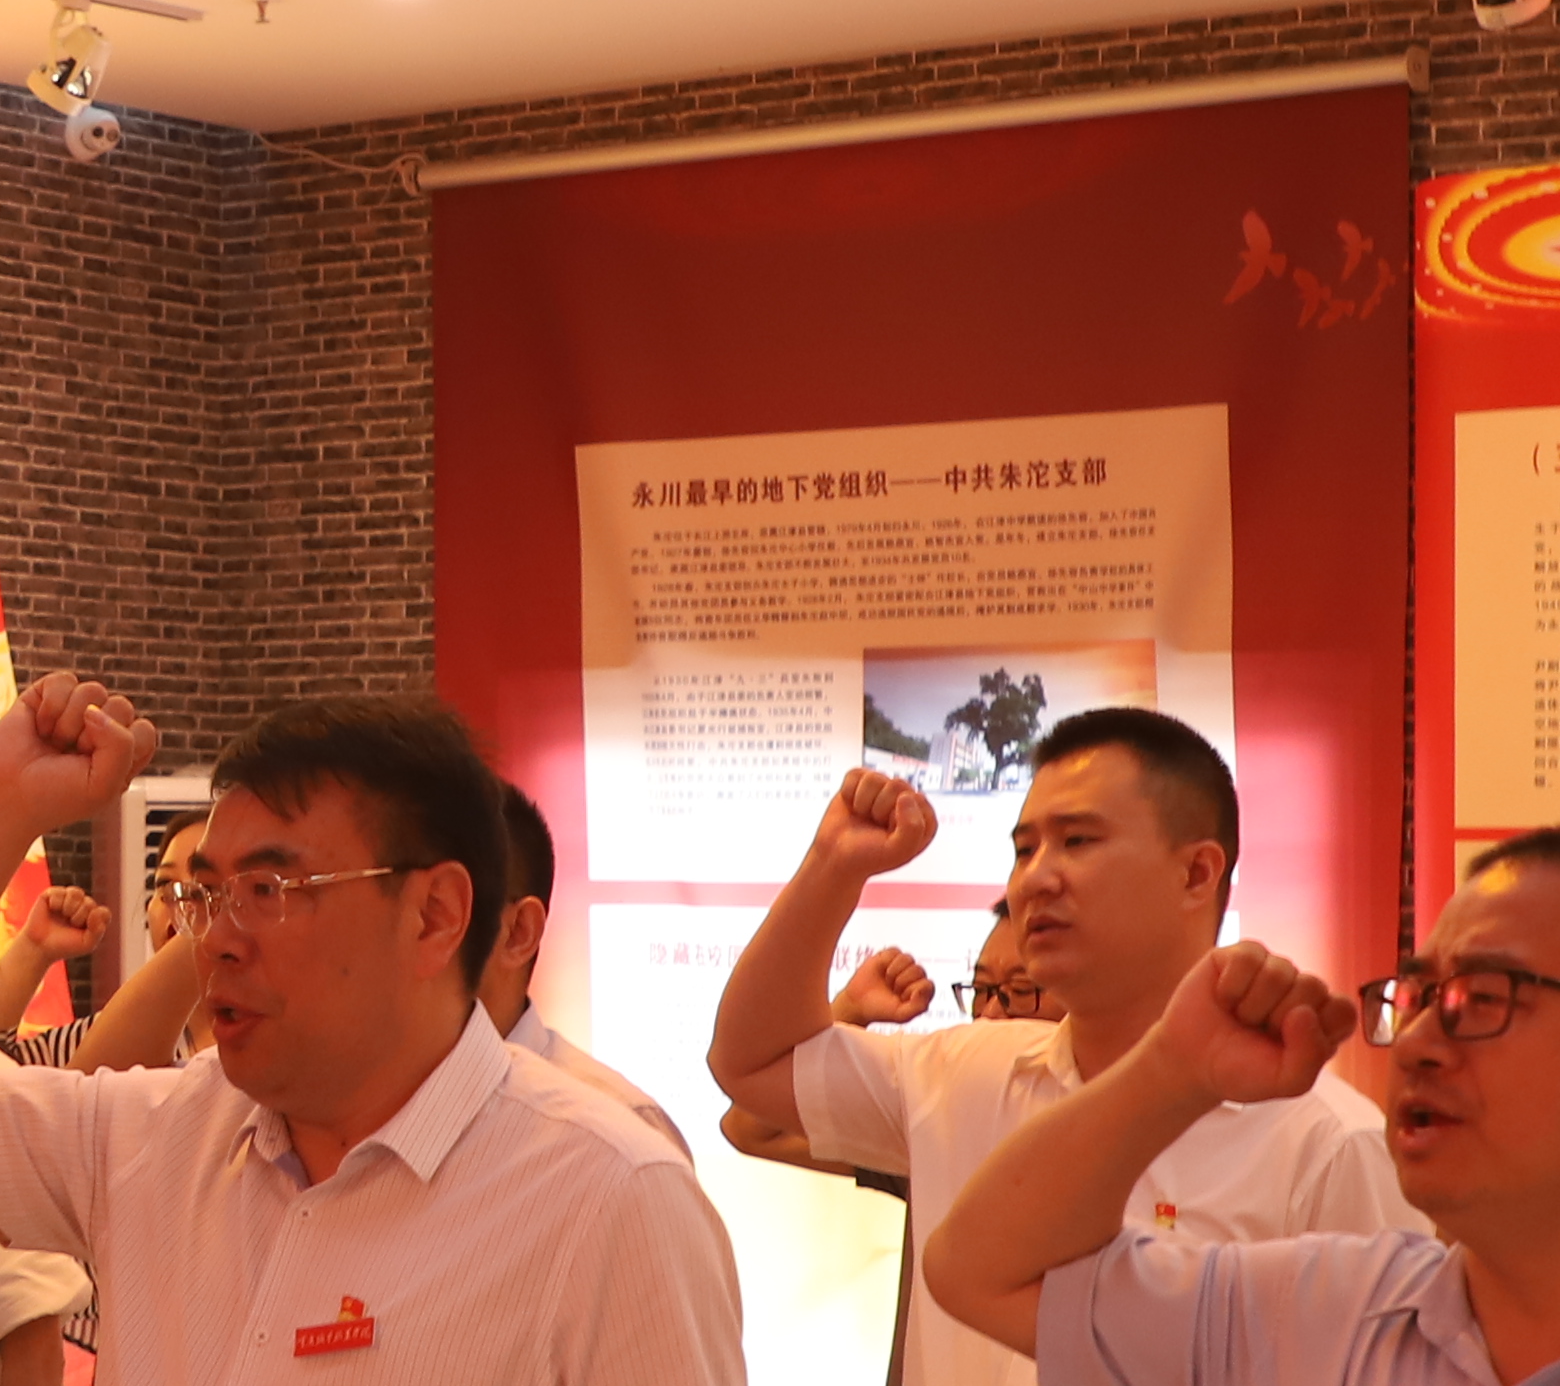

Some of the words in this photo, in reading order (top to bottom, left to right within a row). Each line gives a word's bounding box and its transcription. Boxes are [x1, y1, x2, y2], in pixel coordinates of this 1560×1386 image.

[631, 457, 1109, 511] 永川最早的地下党组织——中共朱沱支部
